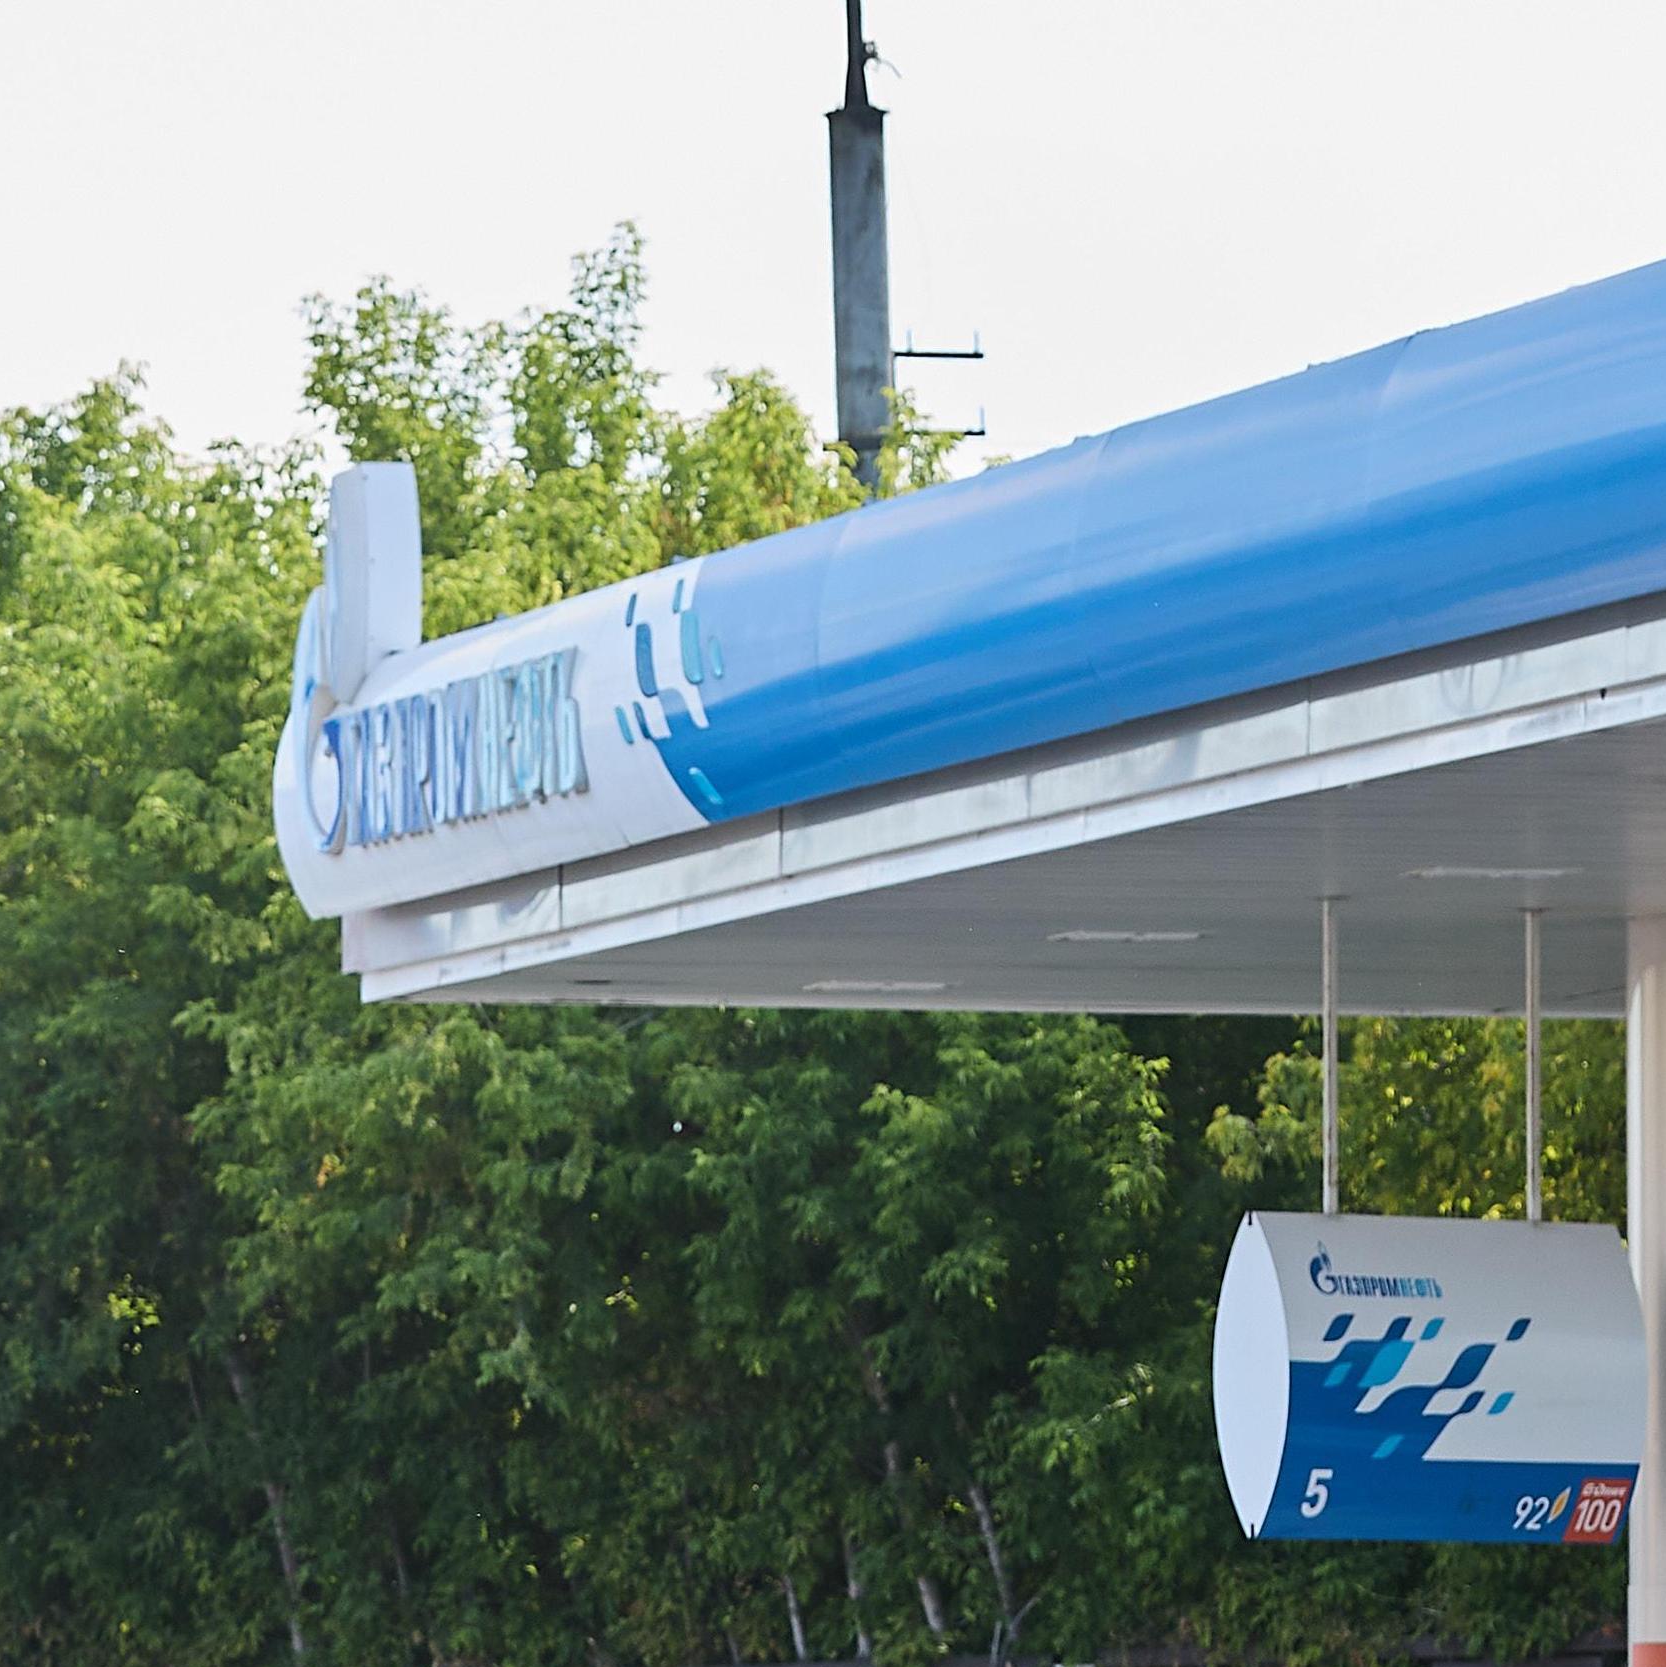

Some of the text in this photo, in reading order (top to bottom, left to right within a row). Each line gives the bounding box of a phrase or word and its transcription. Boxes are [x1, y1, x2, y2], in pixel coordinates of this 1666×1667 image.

[1337, 1275, 1444, 1299] ГАЗПРОМНЕФТЬ
[1299, 1467, 1333, 1518] 5
[1512, 1495, 1622, 1534] 92 100
